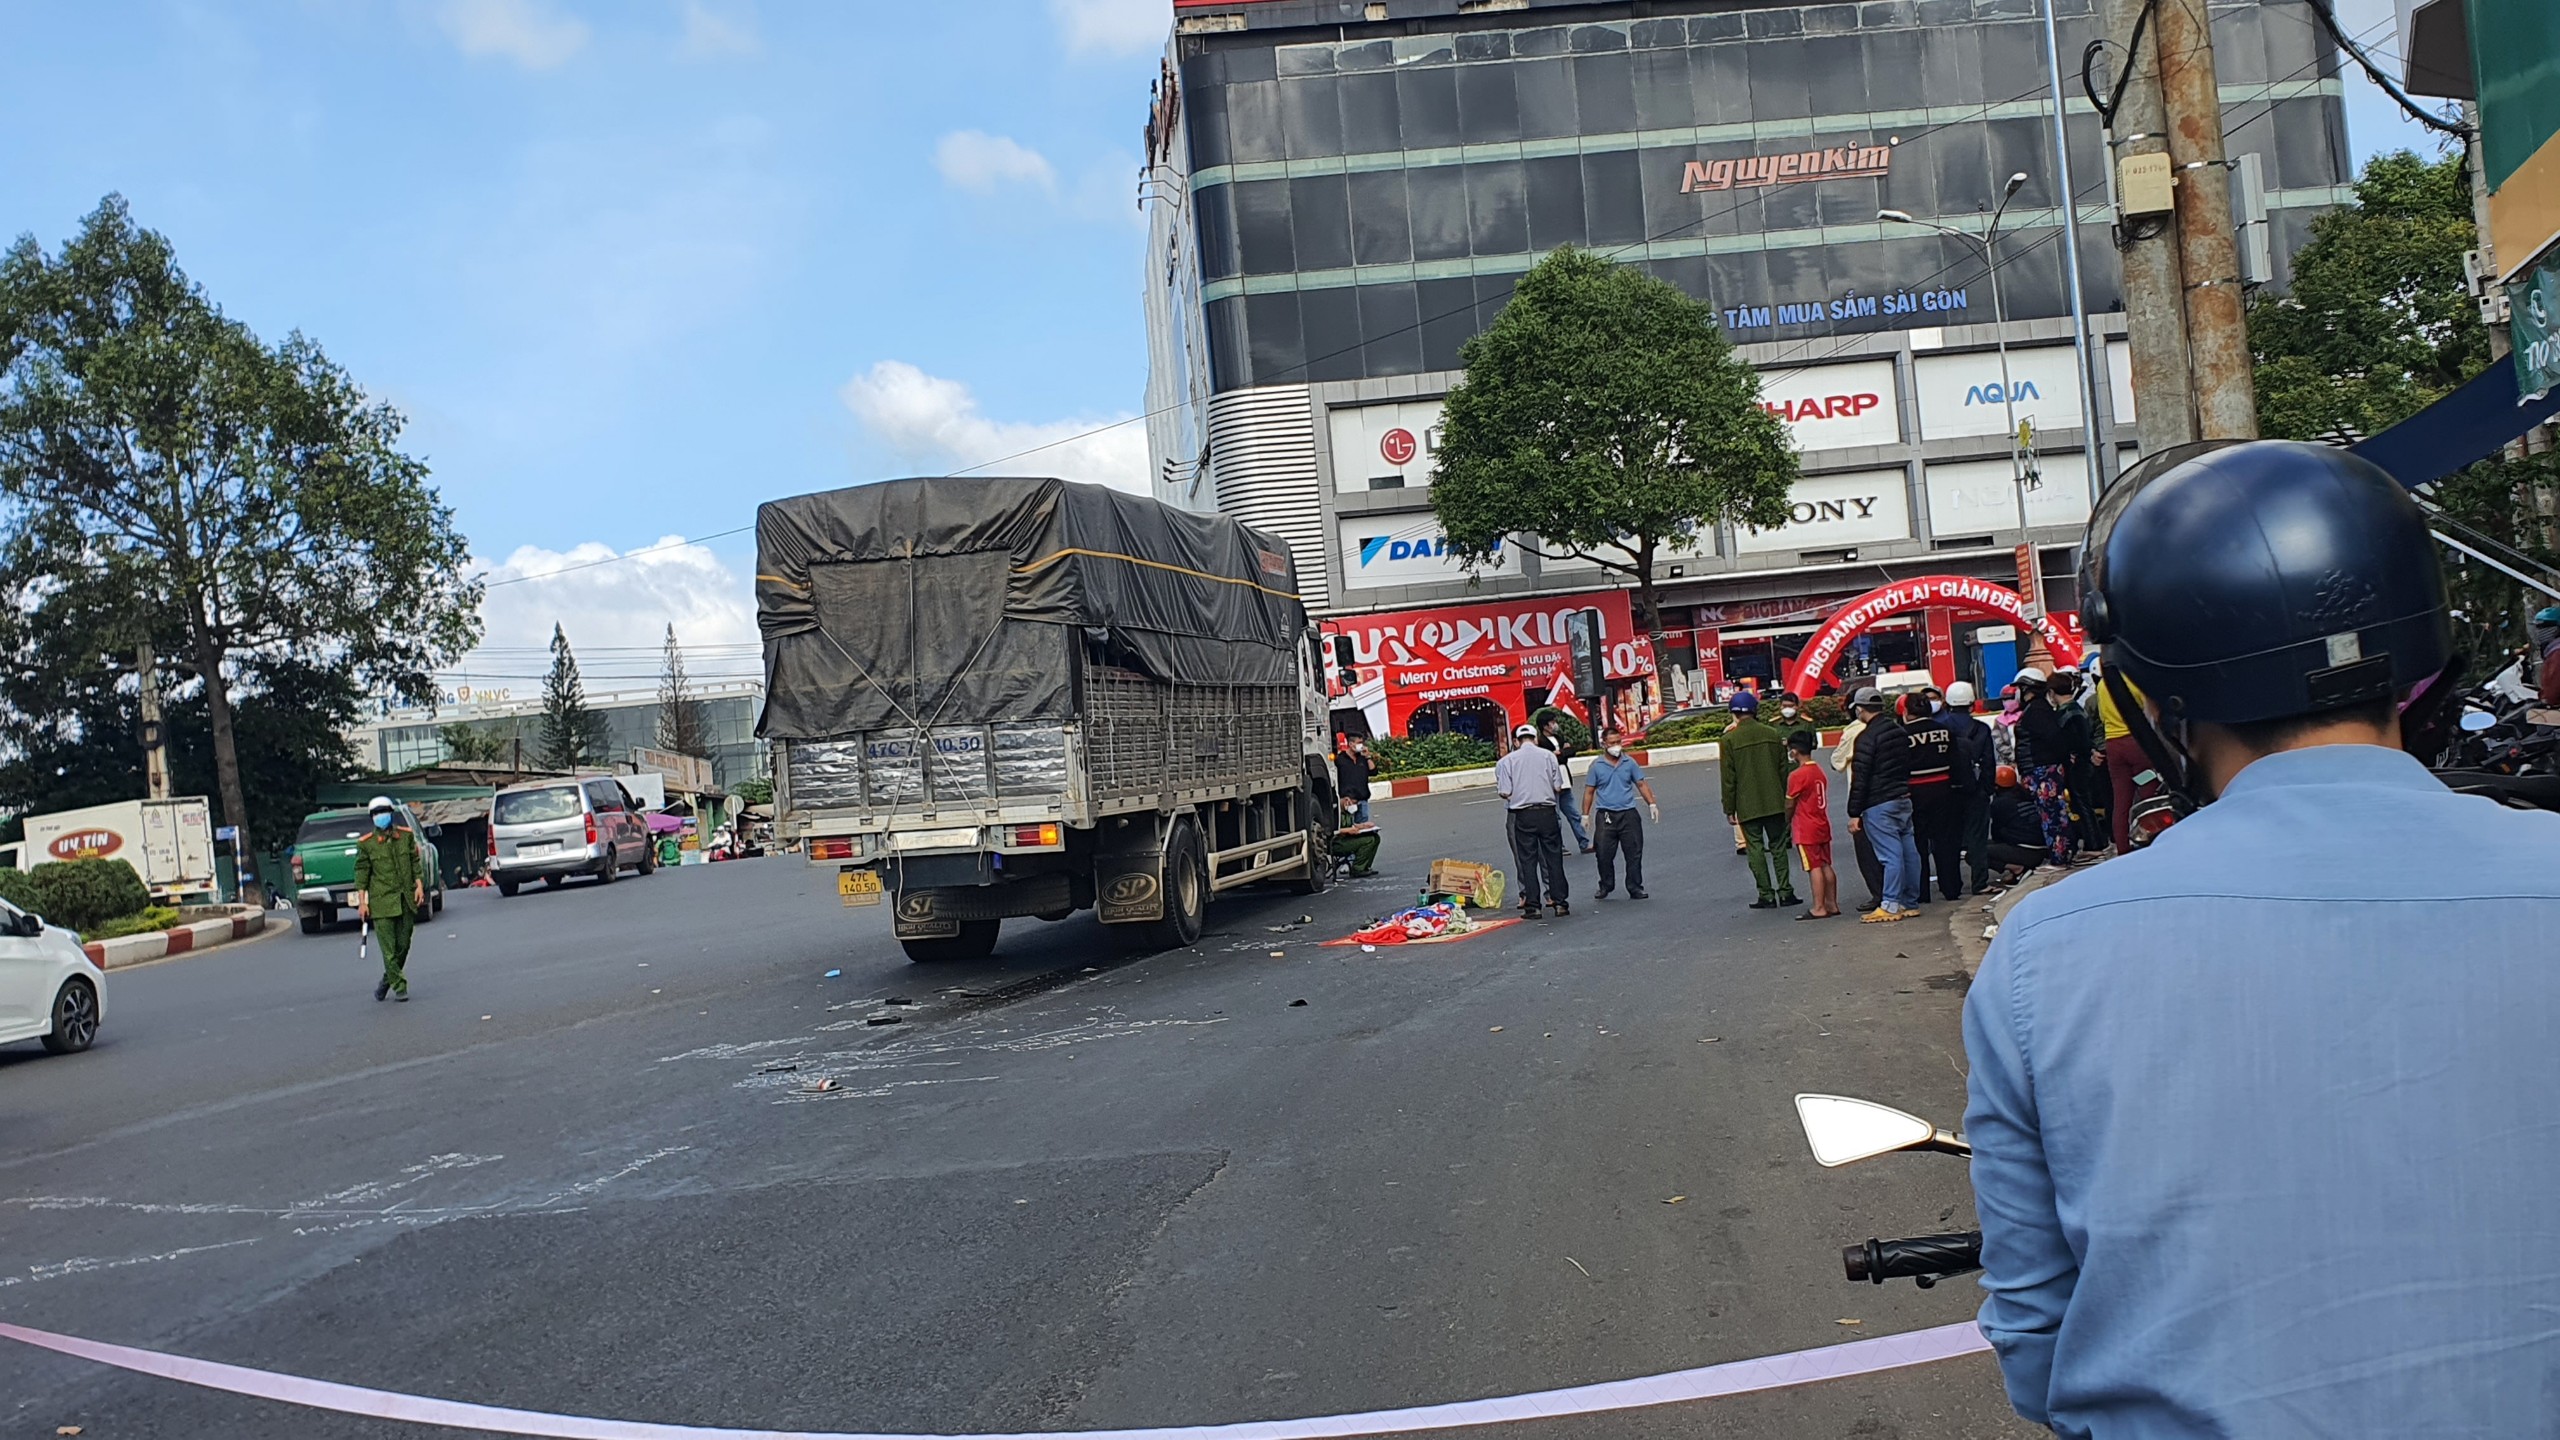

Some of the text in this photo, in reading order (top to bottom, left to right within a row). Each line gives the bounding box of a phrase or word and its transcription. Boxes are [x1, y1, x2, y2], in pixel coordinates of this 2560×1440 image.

[1724, 303, 1771, 329] TÂM
[1778, 301, 1826, 326] MUA
[1830, 289, 1877, 321] SẮM
[1882, 288, 1918, 316] SÀI
[1922, 284, 1967, 313] GÒN
[1964, 380, 2040, 406] AQUA
[1755, 393, 1879, 423] HARP
[1787, 496, 1878, 525] ONY
[1940, 580, 1990, 604] GIẢM
[1700, 647, 1717, 658] NK
[1400, 669, 1438, 686] Merry
[1443, 663, 1506, 681] Christmas
[844, 882, 877, 893] 140.50
[850, 872, 869, 883] 47C
